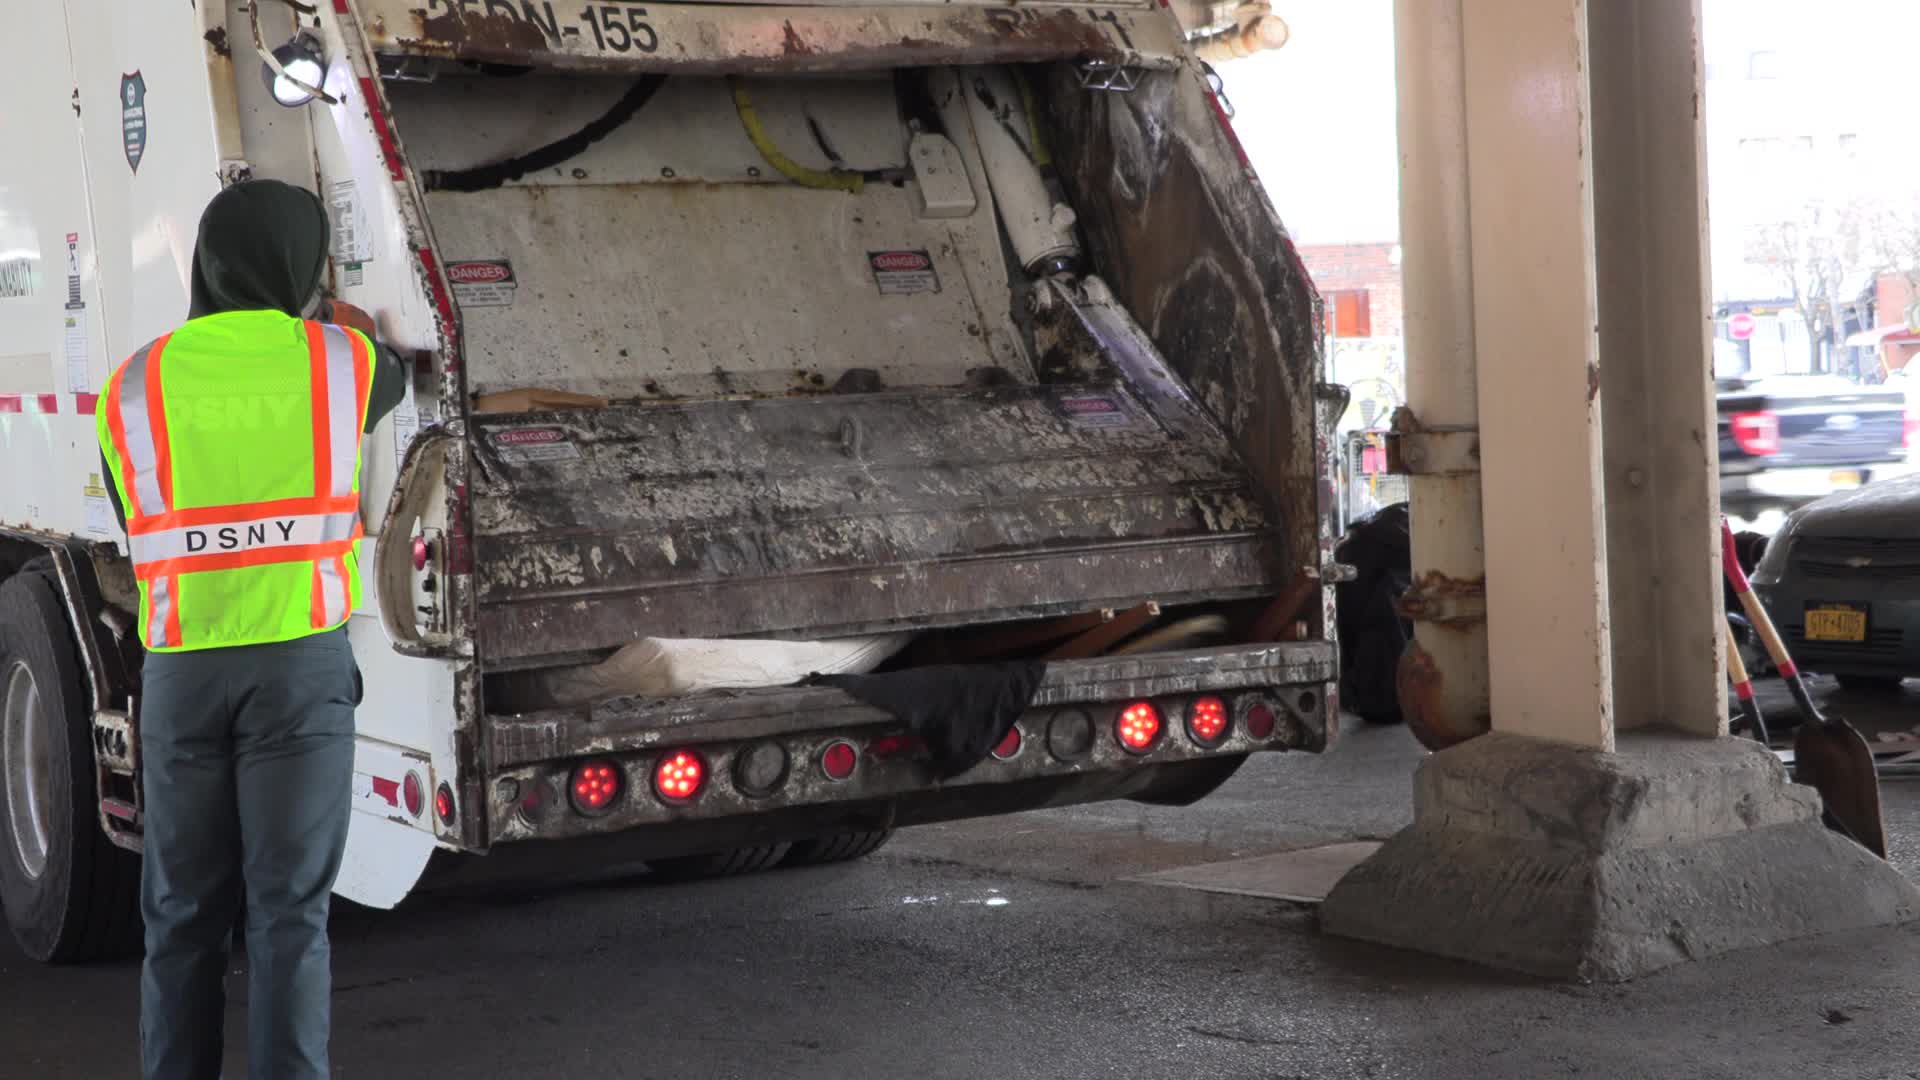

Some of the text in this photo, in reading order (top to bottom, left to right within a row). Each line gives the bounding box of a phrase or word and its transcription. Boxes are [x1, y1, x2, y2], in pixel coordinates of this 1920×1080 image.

[450, 266, 506, 279] DANGER
[173, 393, 303, 430] DSNY
[499, 431, 558, 442] DANGER
[186, 520, 296, 552] DSNY
